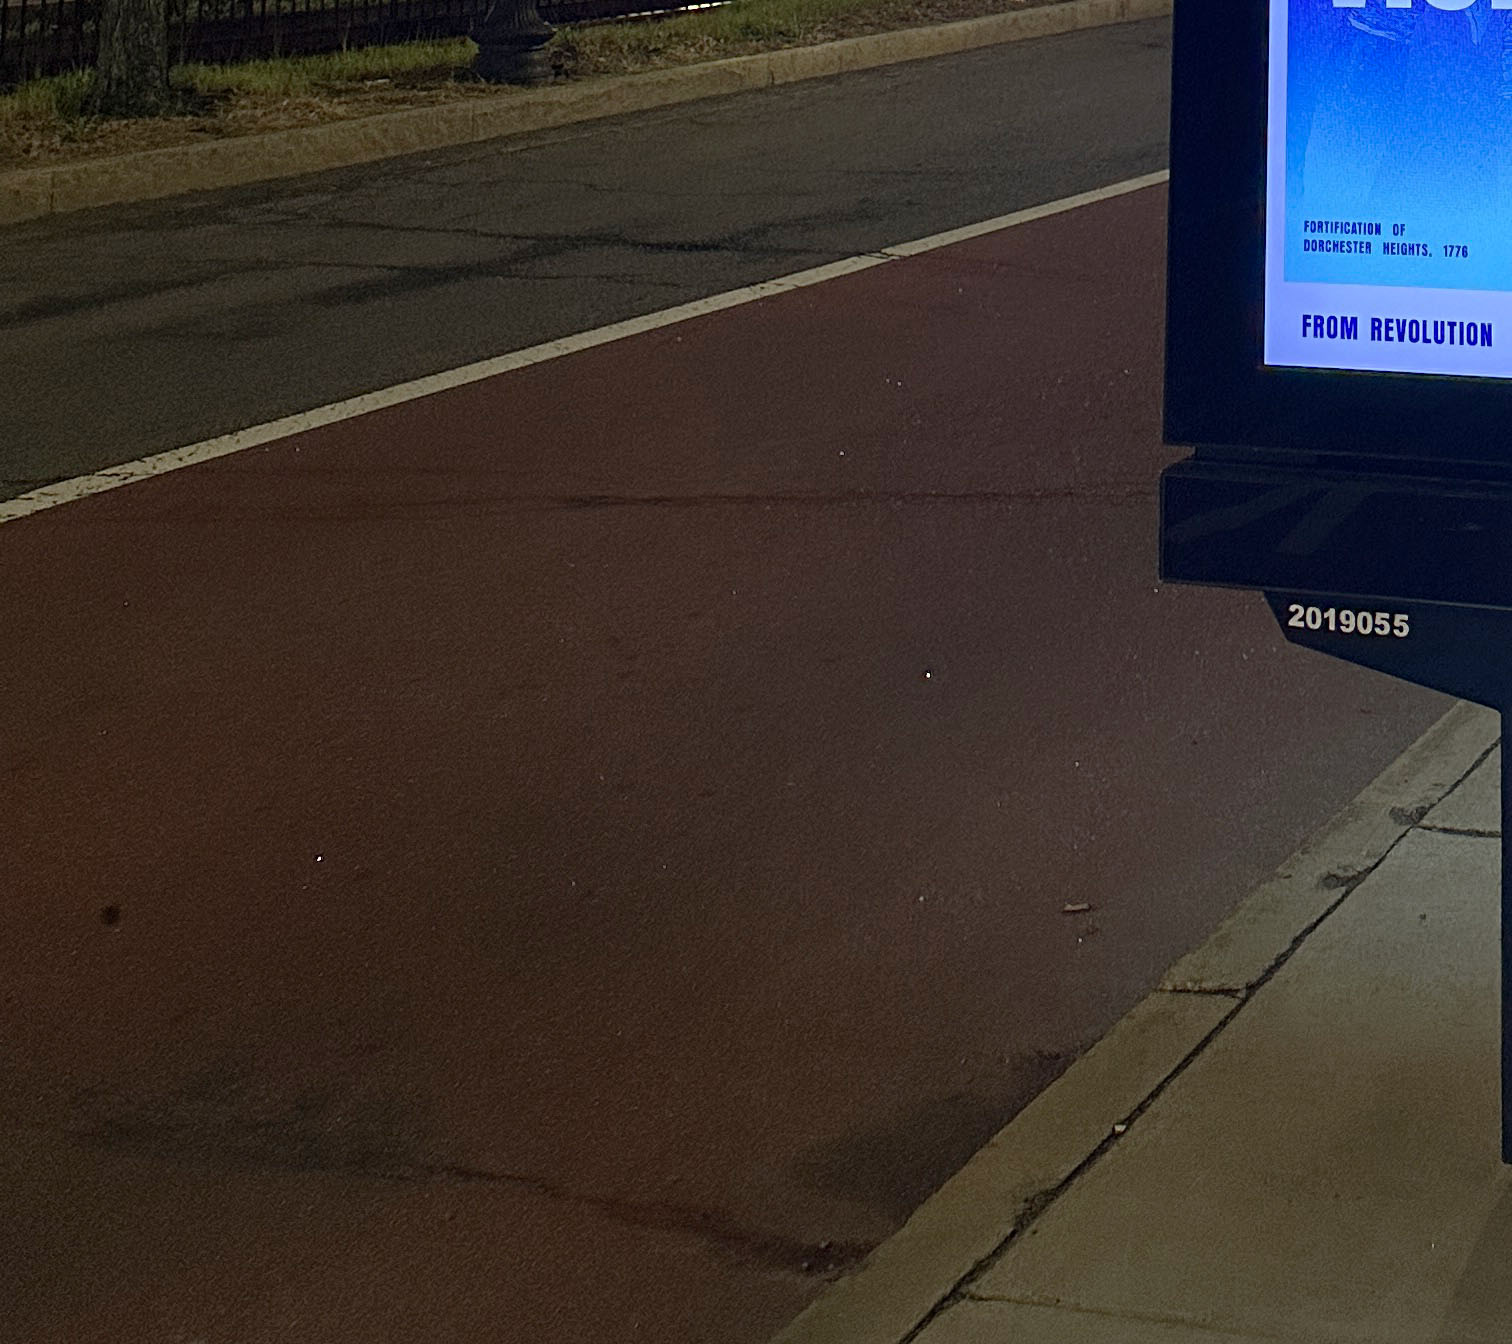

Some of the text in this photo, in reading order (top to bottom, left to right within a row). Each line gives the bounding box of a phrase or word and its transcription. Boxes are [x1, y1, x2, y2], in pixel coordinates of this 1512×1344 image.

[1303, 220, 1406, 237] FORTIFICATION OF
[1303, 239, 1372, 255] DORCHESTER
[1442, 244, 1469, 259] 1776
[1302, 314, 1494, 348] FROM REVOLUTION
[1287, 603, 1411, 639] 2019055
